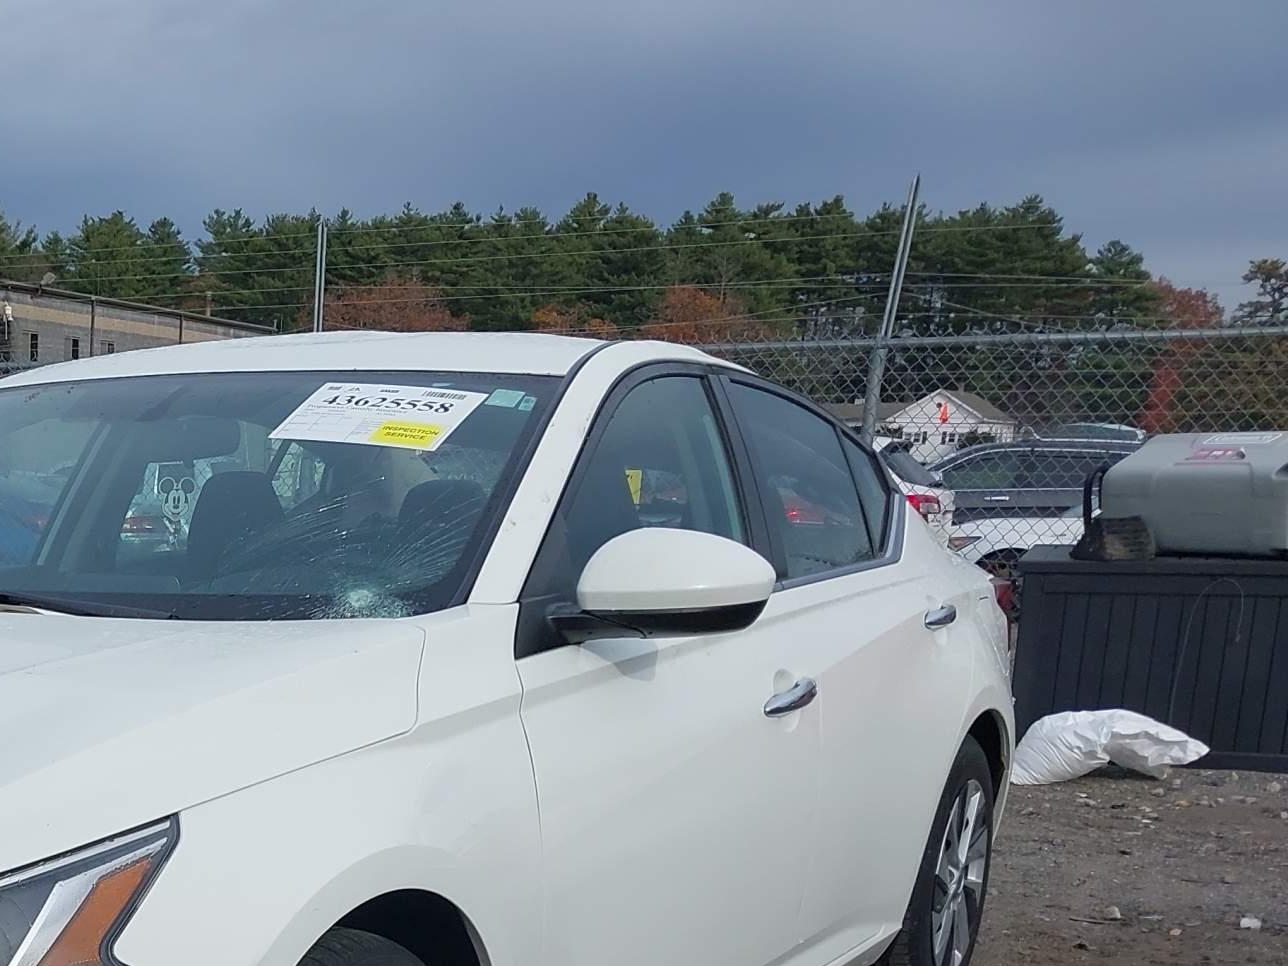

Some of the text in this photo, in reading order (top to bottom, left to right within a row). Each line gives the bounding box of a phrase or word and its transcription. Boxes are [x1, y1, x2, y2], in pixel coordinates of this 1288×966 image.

[323, 395, 454, 414] 43625558
[383, 426, 440, 436] INSPECTION
[384, 431, 427, 440] SERVICE
